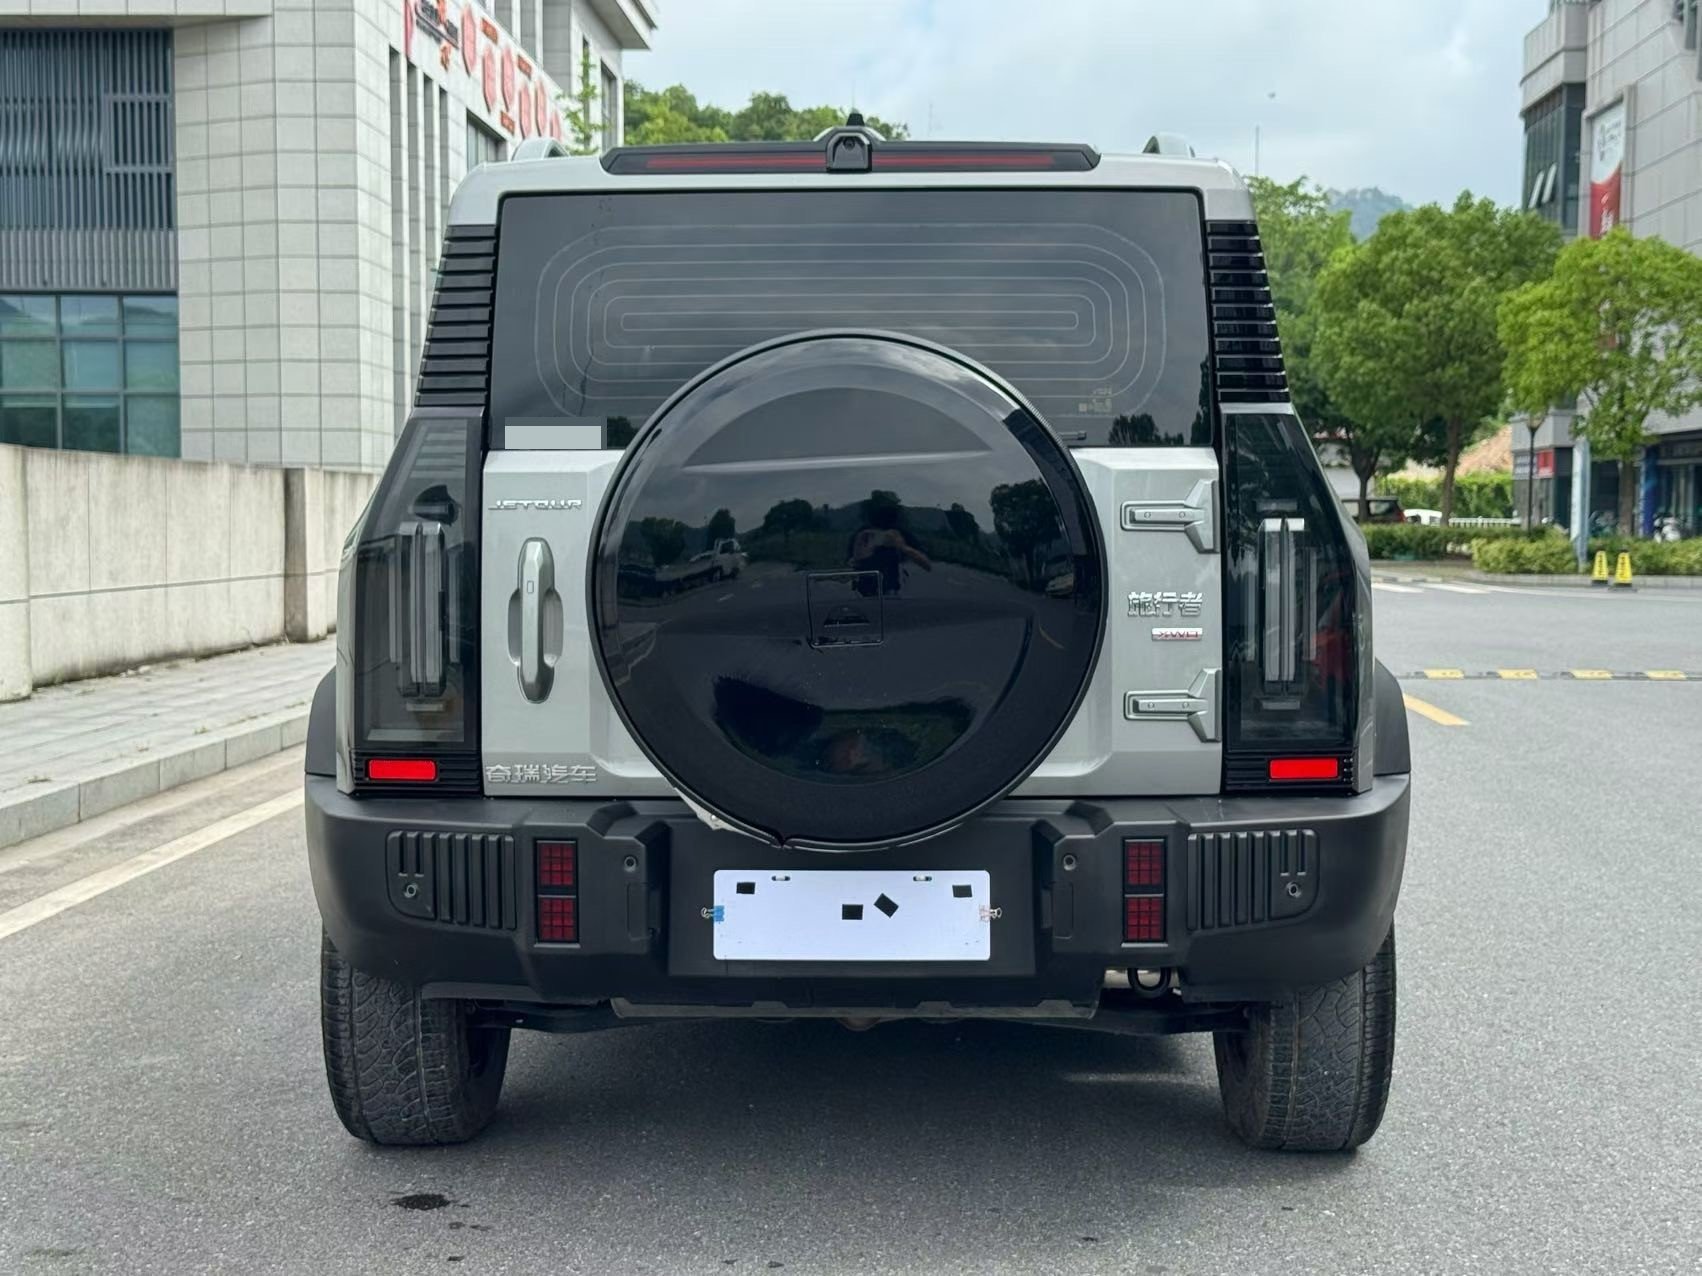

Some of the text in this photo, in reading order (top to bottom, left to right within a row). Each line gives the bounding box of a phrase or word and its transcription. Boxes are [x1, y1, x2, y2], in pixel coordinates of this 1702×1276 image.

[488, 499, 583, 511] JETOUR
[1127, 591, 1203, 617] 旅行者
[485, 764, 597, 784] 奇瑞汽车
